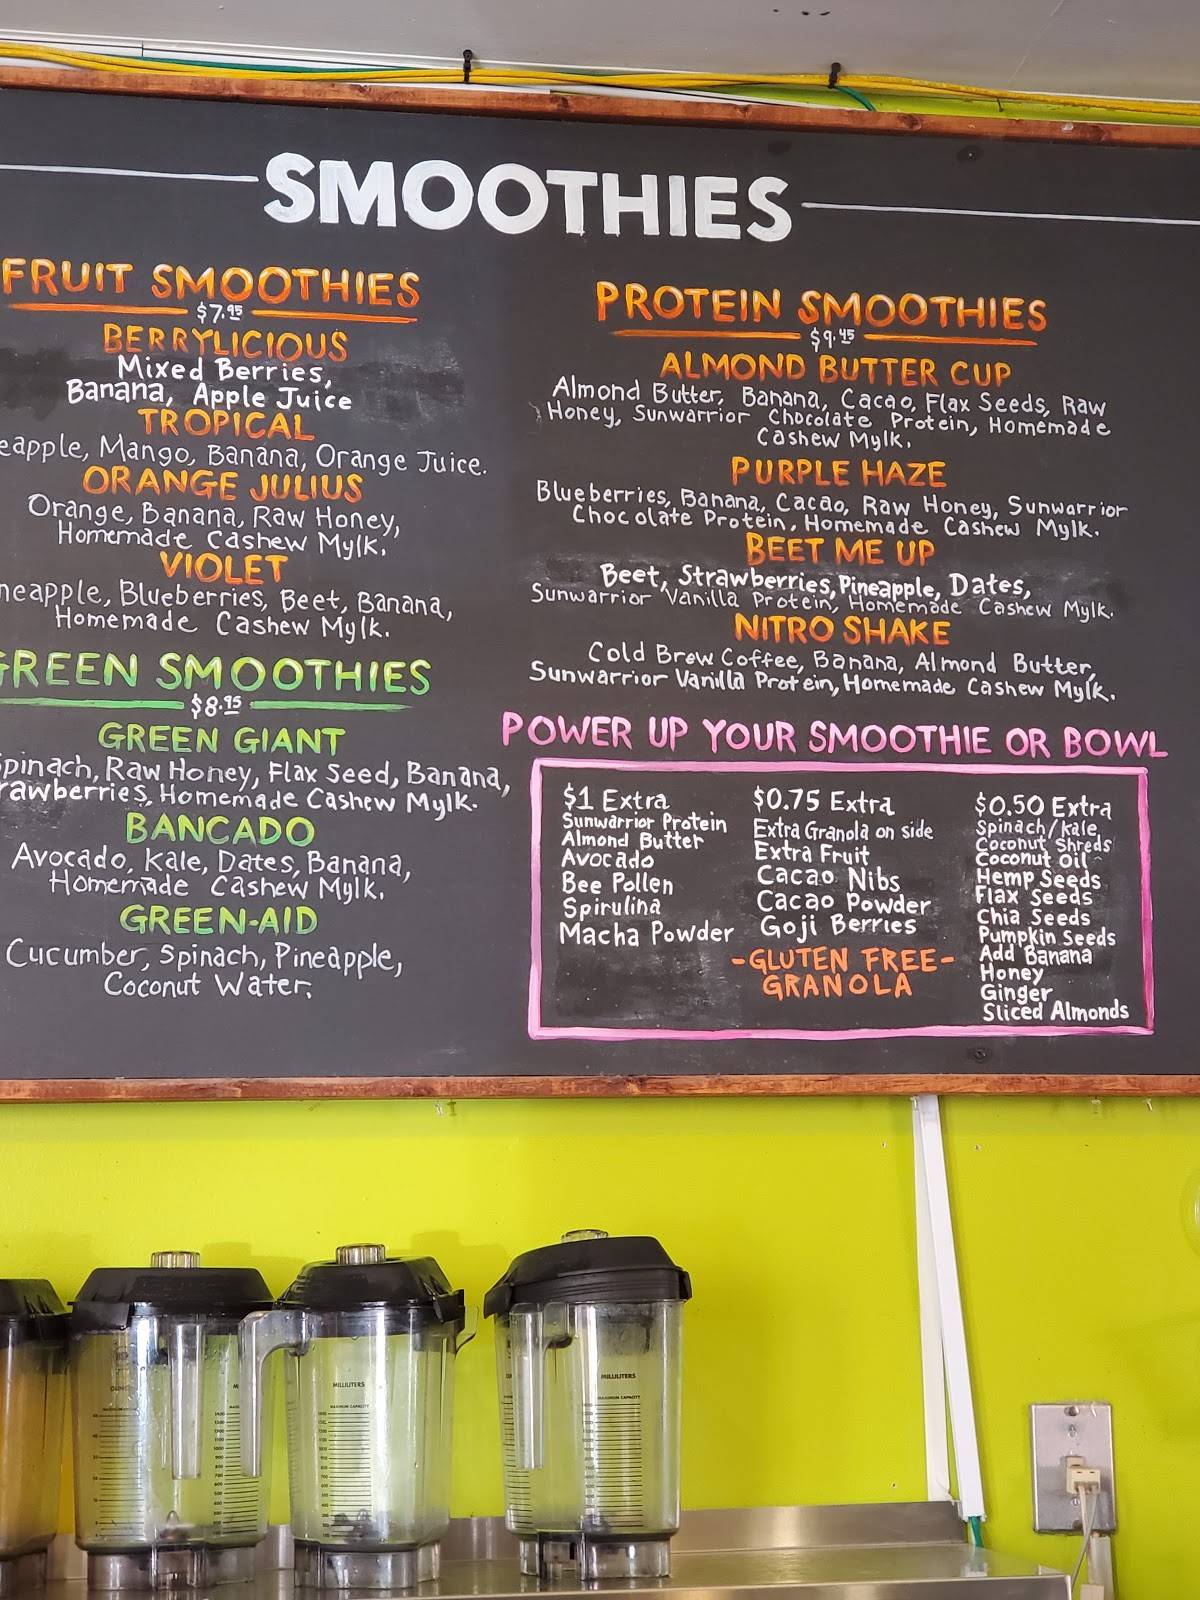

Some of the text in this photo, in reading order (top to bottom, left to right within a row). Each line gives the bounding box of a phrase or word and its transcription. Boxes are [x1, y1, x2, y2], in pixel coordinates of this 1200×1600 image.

[264, 152, 792, 241] SMOOTHIES
[2, 258, 419, 308] FRUIT SMOOTHIES
[197, 302, 242, 324] $7.95
[597, 281, 1046, 332] PROTEIN SMOOTHIES
[104, 323, 347, 363] BERRYLICIOUS
[811, 327, 854, 352] $9.45
[118, 354, 331, 389] Mixed Berries,
[661, 351, 1010, 386] ALMOND BUTTER CUP
[66, 379, 352, 411] Banana, Apple Juice
[553, 375, 1106, 417] Almond Butter, Banana, Cacao, Flax Seeds, Raw
[138, 408, 315, 440] TROPICAL
[548, 400, 1110, 437] Honey, Sunwarrior Chocolate Protein, Homemade
[757, 427, 910, 451] Cashew Mylk.
[100, 434, 195, 466] Mango,
[208, 445, 306, 472] Banana,
[316, 444, 407, 476] Orange
[417, 451, 486, 475] Juice.
[83, 466, 363, 503] ORANGE JULIUS
[732, 456, 946, 487] PURPLE HAZE
[538, 480, 1127, 523] Blueberries, Cacao, Raw Honey, Sunwarrior
[28, 494, 399, 540] Orange, Banana, Raw Honey,
[573, 504, 796, 531] Chocolate Protein,
[746, 532, 934, 566] BEET ME UP
[160, 551, 288, 585] VIOLET
[120, 579, 267, 611] Blueberries,
[600, 563, 1030, 605] Beet, Strawberries, Pineapple, Dates,
[735, 613, 950, 645] NITRO SHAKE
[589, 641, 996, 674] Cold Brew Coffee, Almond
[156, 653, 431, 695] SMOOTHIES
[191, 693, 241, 719] $8.95
[99, 722, 345, 756] GREEN GIANT
[503, 711, 1168, 758] POWER UP YOUR SMOOTHIE OR BOWL
[407, 761, 510, 798] Banana,
[160, 783, 477, 821] Homemade Cashew Mylk.
[564, 782, 670, 813] $1 Extra
[753, 786, 895, 816] $0.75 Extra
[975, 792, 1111, 820] $0.50 Extra
[127, 812, 314, 846] BANCADO
[562, 811, 727, 833] Sunwarrior Protein
[754, 816, 933, 842] Extra Granola on side
[561, 829, 704, 850] Almond Butter
[754, 839, 870, 865] Extra Fruit
[976, 835, 1047, 854] Coconut
[12, 842, 410, 883] Avocado, Kale, Dates, Banana,
[561, 848, 654, 869] Avocado
[976, 851, 1087, 869] Coconut Oil
[562, 871, 673, 895] Bee Pollen
[757, 865, 900, 892] Cacao Nibs
[976, 868, 1101, 890] Hemp Seeds
[563, 895, 660, 921] Spirulina
[757, 890, 931, 915] Cacao Powder
[975, 885, 1092, 906] Flax Seeds
[120, 905, 317, 935] GREEN-AID
[761, 914, 916, 943] Goji Berries
[977, 907, 1090, 926] Chia Seeds
[560, 920, 734, 947] Macha Powder
[979, 925, 1115, 948] Pumpkin Seeds
[7, 938, 402, 979] Cucumber, Spinach, Pineapple,
[979, 943, 1092, 966] Add Banana
[104, 971, 201, 997] Coconut
[763, 973, 912, 1001] GRANOLA
[980, 962, 1043, 986] Honey
[981, 984, 1053, 1005] Ginger
[983, 999, 1129, 1021] Sliced Almonds
